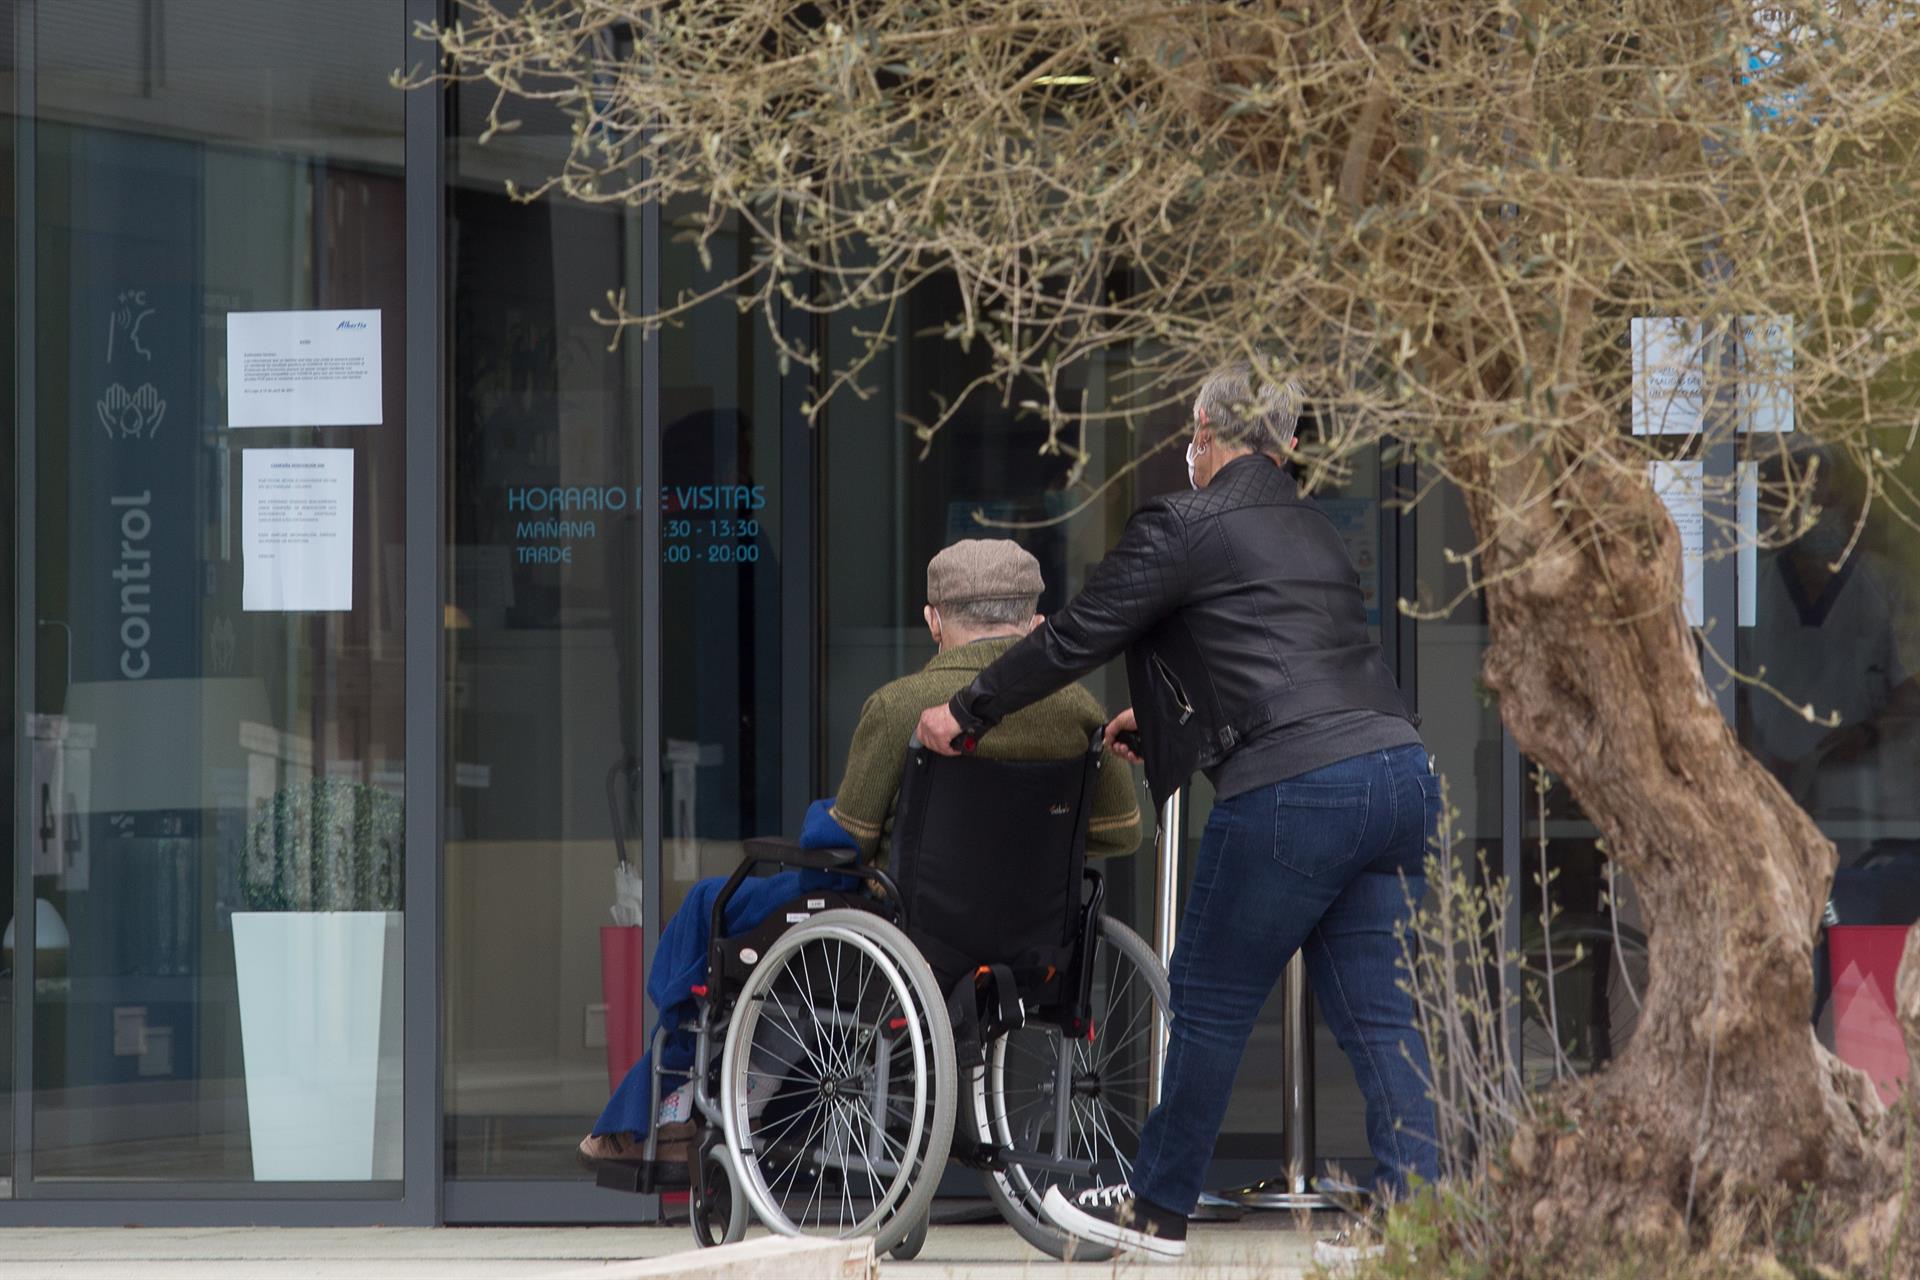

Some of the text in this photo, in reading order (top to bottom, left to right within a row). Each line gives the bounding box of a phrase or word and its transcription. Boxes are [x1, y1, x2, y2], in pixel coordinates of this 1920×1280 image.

[507, 487, 627, 512] HORARIO
[676, 485, 766, 511] VISITAS
[516, 518, 596, 538] MAÑANA
[709, 519, 760, 538] 13:30
[516, 545, 573, 564] TARDE
[707, 544, 760, 563] 20:00
[111, 490, 152, 680] control
